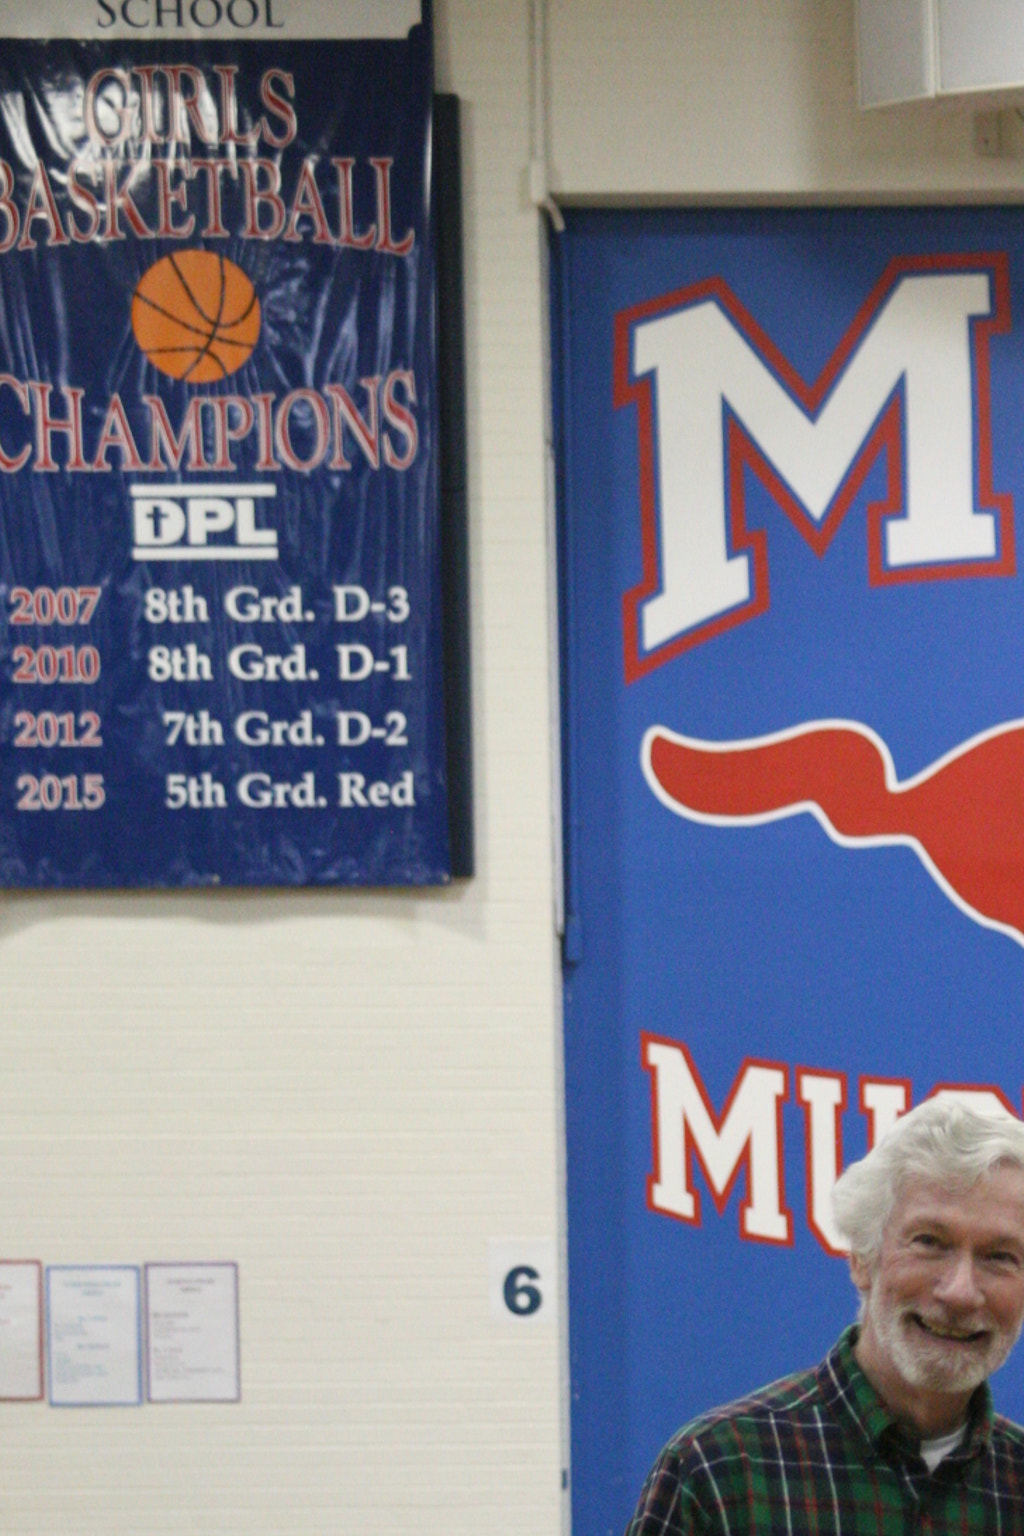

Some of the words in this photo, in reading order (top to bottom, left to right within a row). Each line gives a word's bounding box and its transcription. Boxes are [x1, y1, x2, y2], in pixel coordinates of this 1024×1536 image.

[97, 0, 284, 27] SCHOOL
[83, 64, 298, 148] GIRLS
[0, 369, 418, 473] CHAMPIONS
[132, 497, 278, 546] DPL
[9, 586, 101, 625] 2007
[144, 585, 209, 623] 8th
[225, 585, 315, 623] Grd.
[334, 586, 410, 623] D-3
[11, 644, 100, 684] 2010
[148, 643, 213, 681] 8th
[229, 643, 319, 681] Grd.
[338, 644, 411, 681] D-1
[13, 711, 103, 747] 2012
[162, 710, 225, 746] 7th
[235, 710, 325, 746] Grd.
[337, 711, 408, 746] D-2
[16, 774, 105, 811] 2015
[166, 773, 227, 809] 5th
[237, 773, 327, 808] Grd.
[340, 772, 415, 808] Red
[502, 1264, 543, 1316] 6
